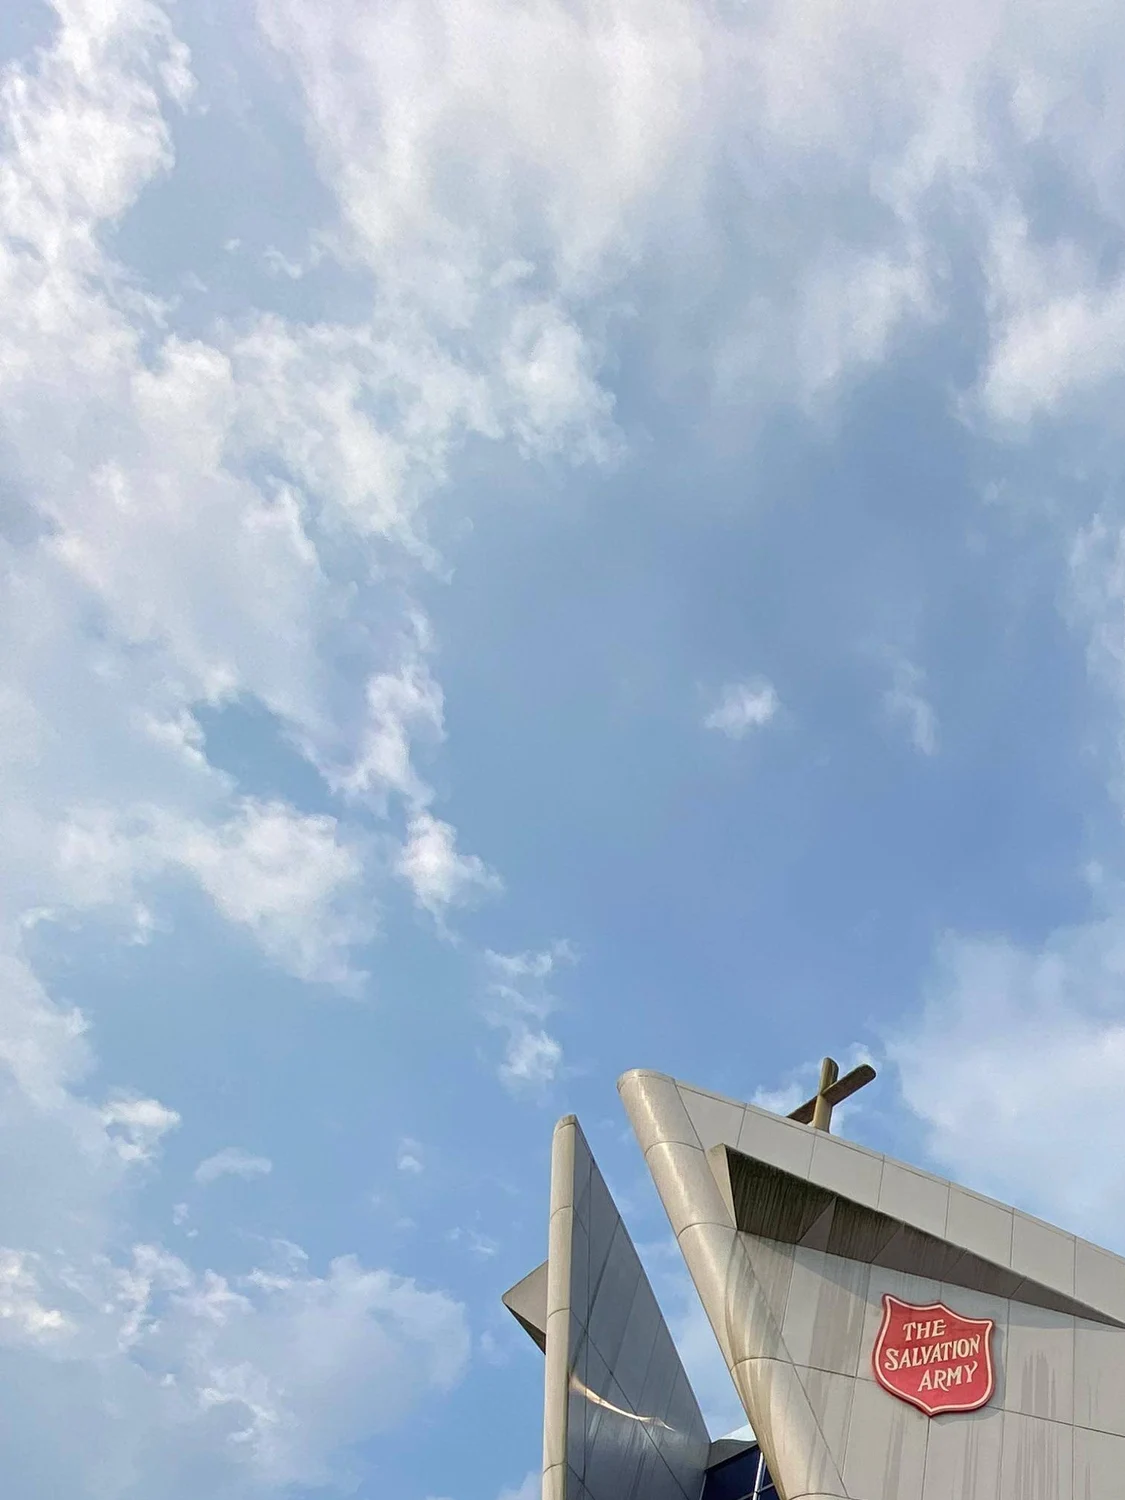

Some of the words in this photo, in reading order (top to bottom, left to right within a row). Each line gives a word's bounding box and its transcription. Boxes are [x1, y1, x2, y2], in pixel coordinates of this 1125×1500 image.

[903, 1319, 946, 1341] THE
[884, 1334, 980, 1371] SALVATION
[917, 1361, 978, 1392] ARMY
